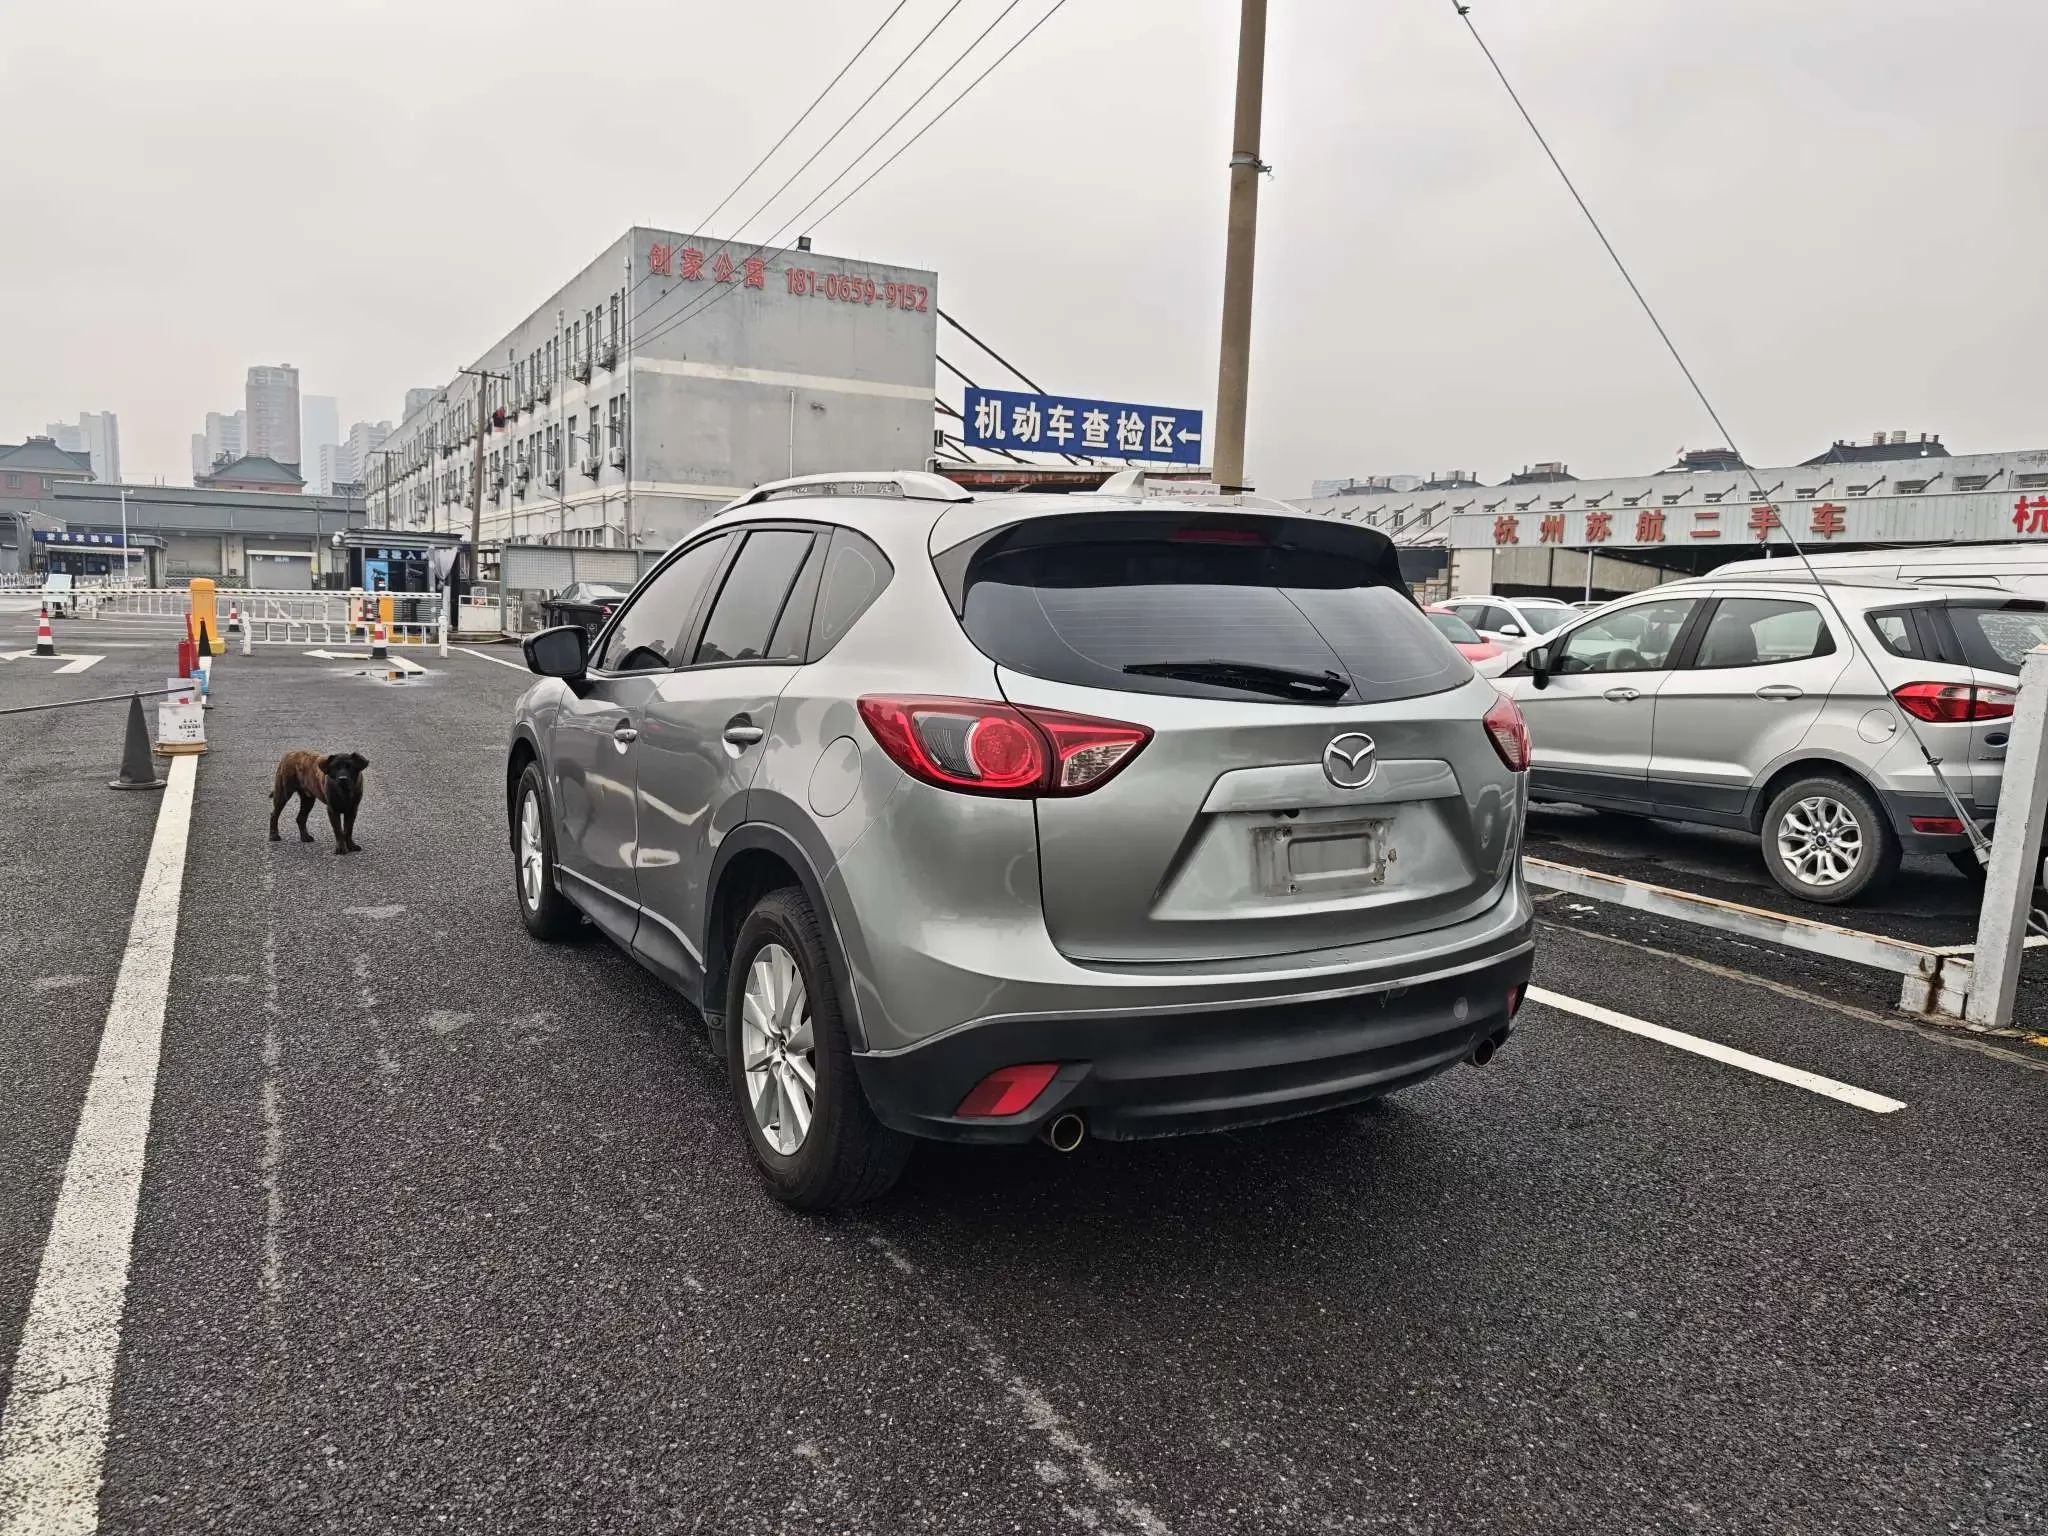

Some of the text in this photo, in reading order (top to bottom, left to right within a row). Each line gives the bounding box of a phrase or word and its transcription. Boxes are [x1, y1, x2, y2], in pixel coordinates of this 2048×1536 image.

[649, 243, 928, 313] 创家公寓 181-0659-9152
[974, 396, 1176, 453] 机动车查检区
[1493, 503, 1846, 545] 杭州苏航二手车
